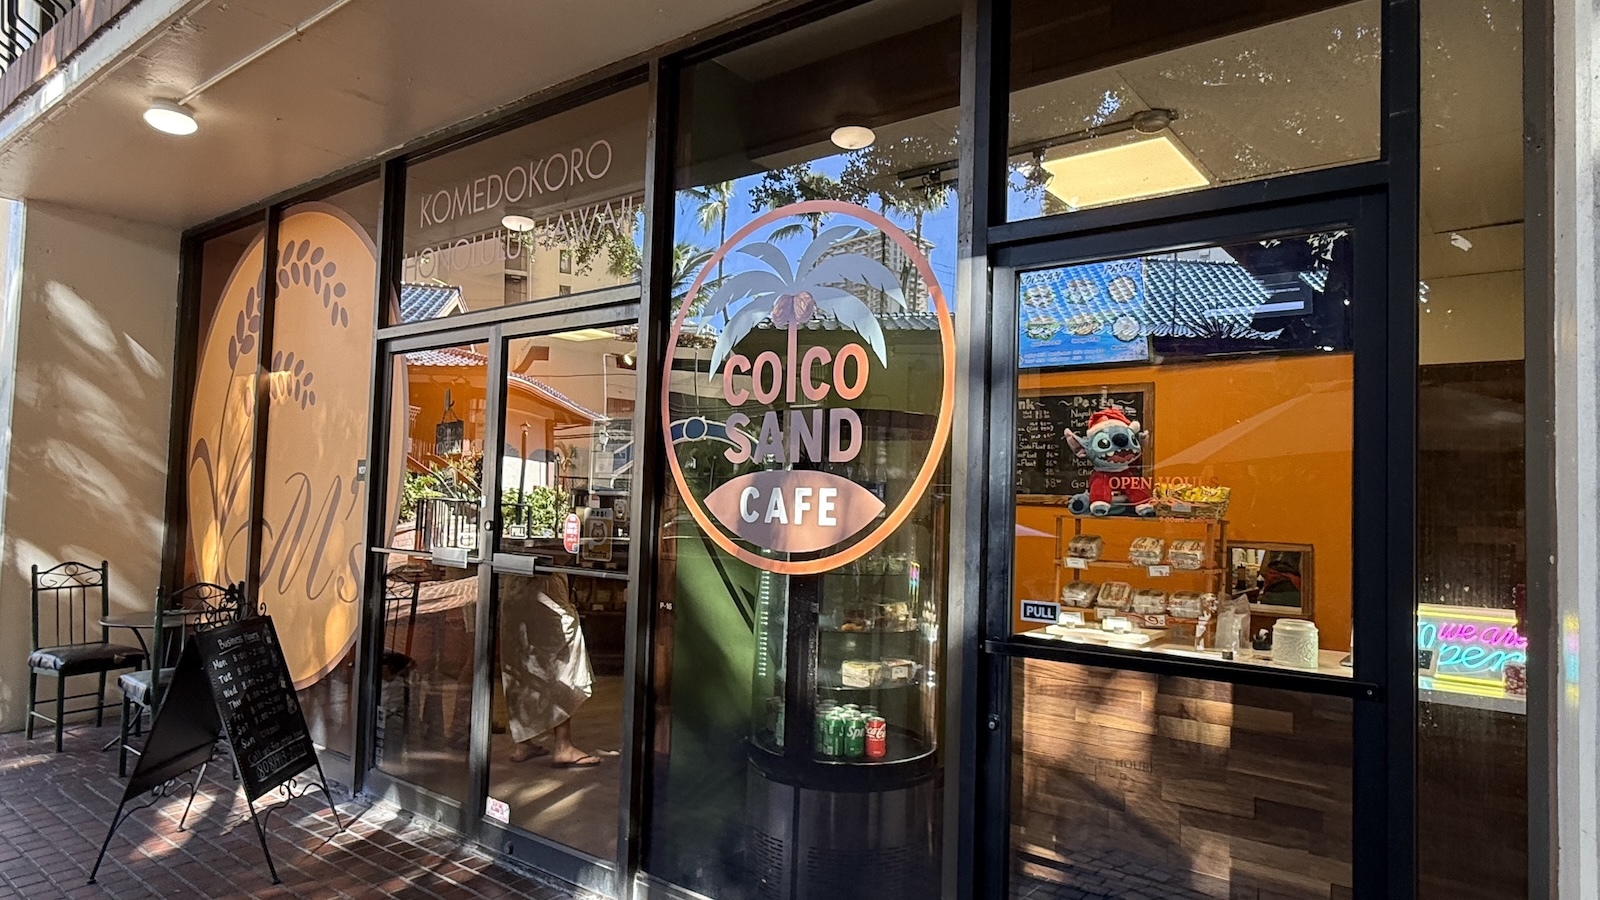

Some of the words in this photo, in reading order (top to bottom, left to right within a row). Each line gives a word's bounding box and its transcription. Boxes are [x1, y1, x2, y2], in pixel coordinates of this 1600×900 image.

[420, 139, 612, 228] KOMEDOKORO
[403, 224, 522, 281] HONOLULU
[536, 196, 632, 251] HAWAII
[724, 408, 863, 464] SAND
[1109, 476, 1153, 490] OPEN
[739, 486, 838, 527] CAFE
[1026, 605, 1055, 619] PULL
[1438, 622, 1478, 641] we
[212, 659, 228, 671] Mon
[218, 672, 233, 684] Tue
[223, 684, 238, 698] Wed
[240, 737, 256, 749] Sun
